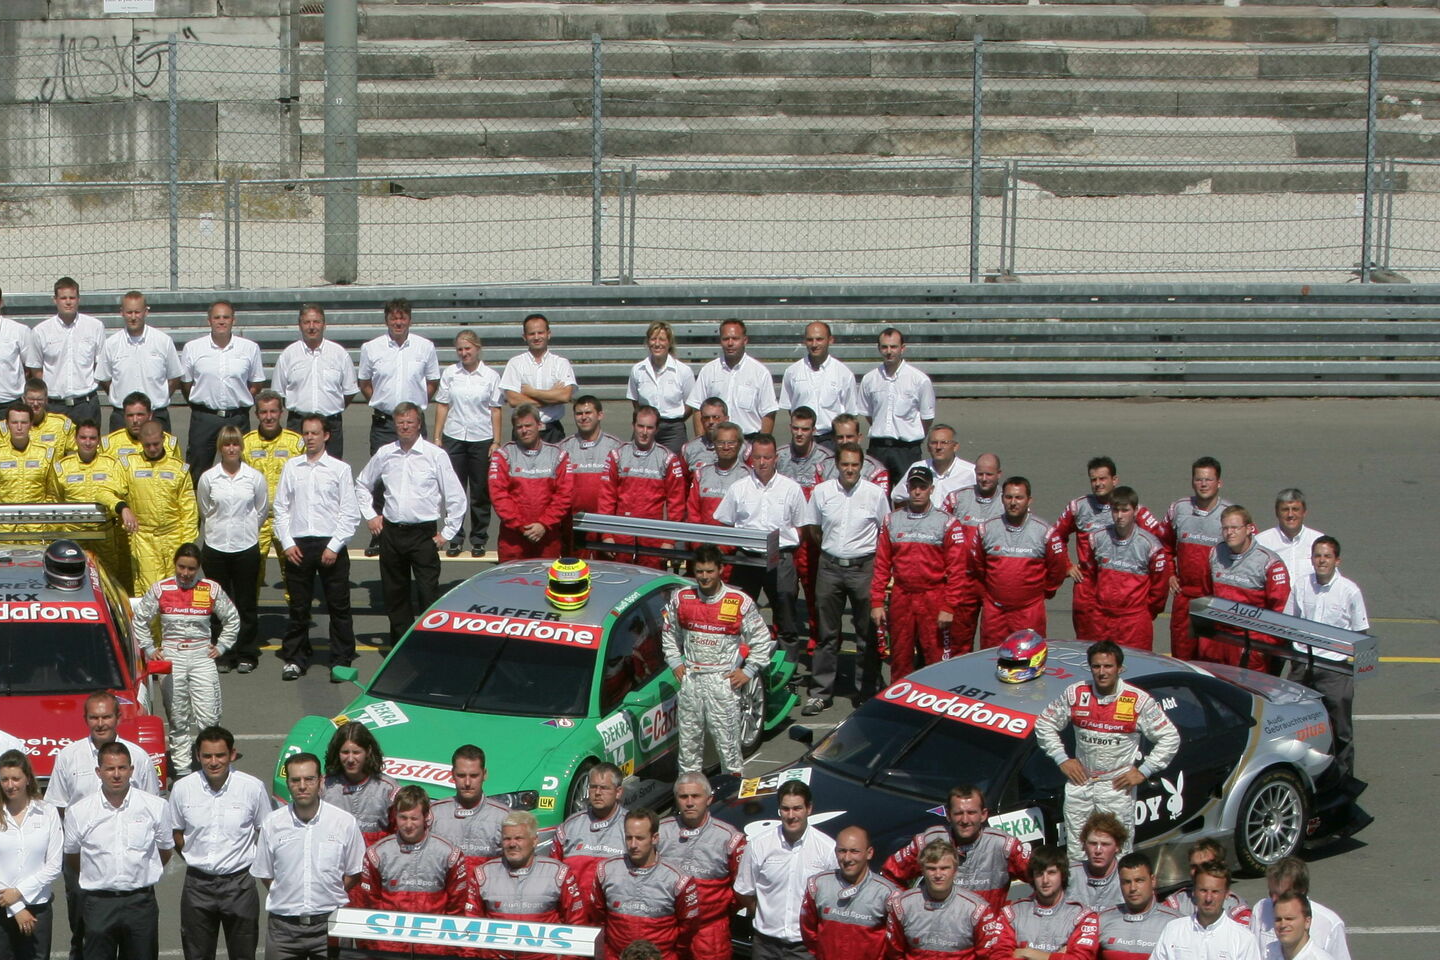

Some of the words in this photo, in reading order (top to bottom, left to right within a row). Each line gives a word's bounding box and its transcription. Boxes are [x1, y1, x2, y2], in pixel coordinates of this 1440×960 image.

[626, 590, 642, 605] Sport
[466, 603, 563, 622] KAFFER
[1228, 602, 1263, 619] Audi
[452, 616, 595, 645] vodafone
[694, 623, 708, 631] Audi
[707, 624, 727, 632] Sport
[947, 683, 997, 702] ABT
[371, 702, 400, 725] DEKRA
[906, 688, 1029, 734] vodafone
[1162, 697, 1177, 711] Abt
[1087, 721, 1104, 730] Audi
[1103, 723, 1125, 732] Sport
[1264, 710, 1324, 735] Gebrauchtwagen
[1266, 715, 1285, 728] Audi
[602, 722, 632, 746] DEKRA
[365, 912, 573, 949] SIEMENS
